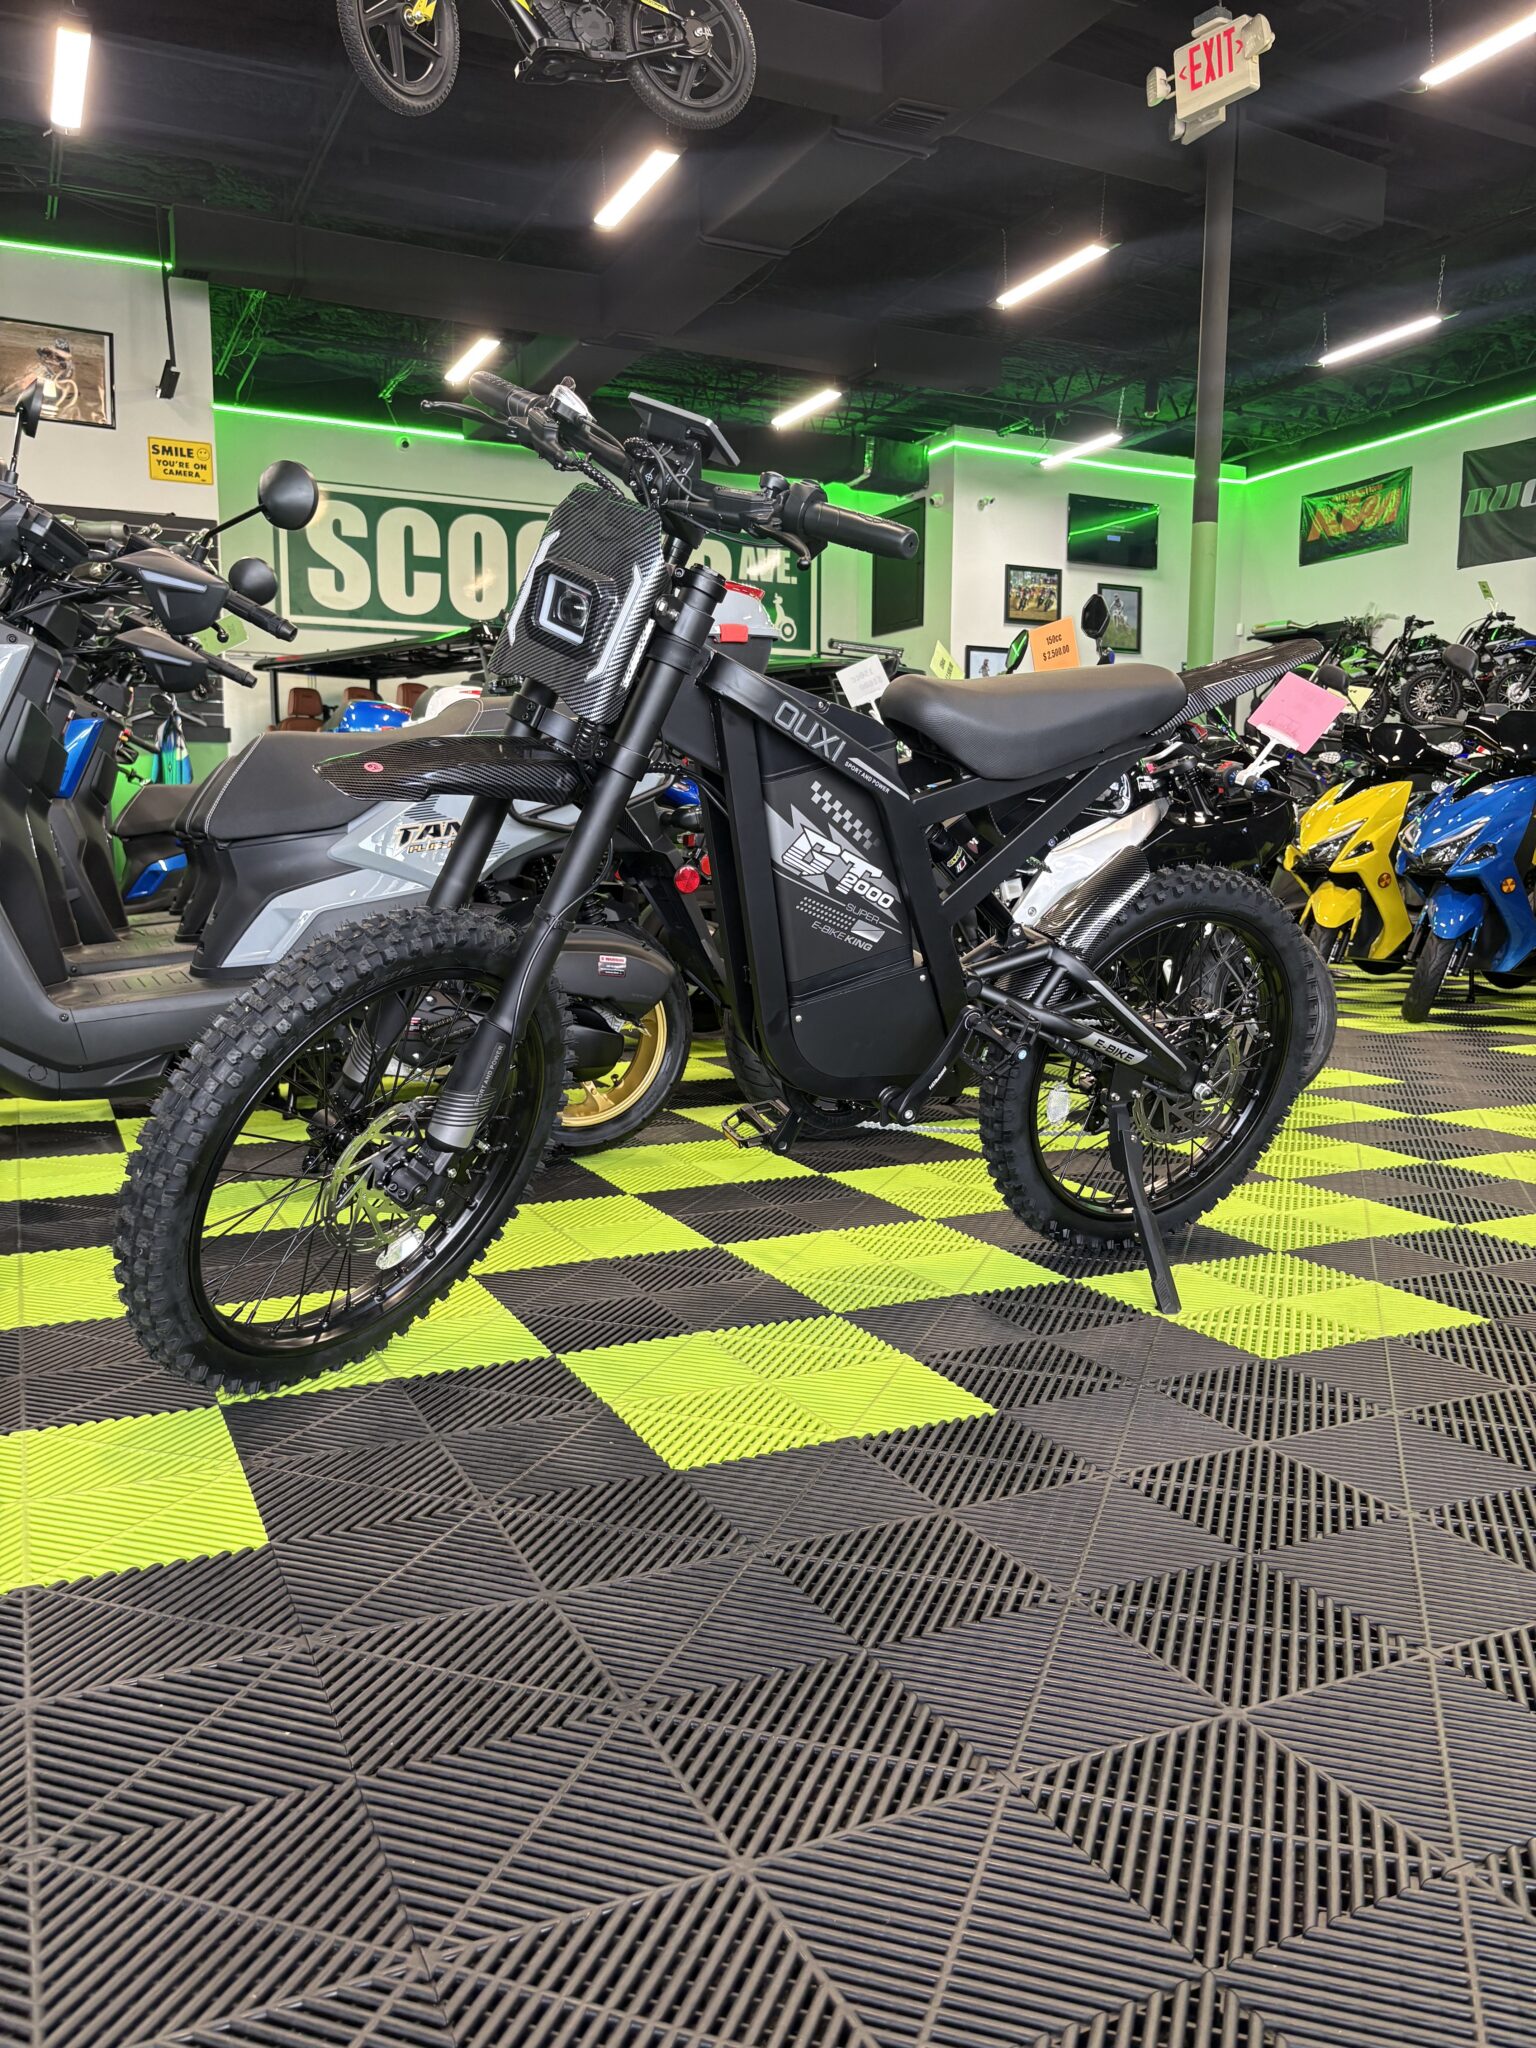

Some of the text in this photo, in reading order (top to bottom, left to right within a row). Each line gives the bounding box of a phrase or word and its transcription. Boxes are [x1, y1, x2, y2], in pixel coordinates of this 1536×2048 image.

[1188, 26, 1236, 92] EXIT
[151, 444, 195, 459] SMILE
[156, 459, 207, 471] YOU'RE ON
[163, 468, 201, 478] CAMERA
[738, 545, 798, 585] AVE.
[774, 701, 847, 763] OUXI
[844, 760, 891, 794] SPORT AND POWER
[835, 871, 895, 909] 2000
[845, 903, 881, 924] SUPER
[483, 1069, 494, 1085] AND
[489, 1045, 505, 1071] POWER
[1094, 1038, 1136, 1062] E-BIKE
